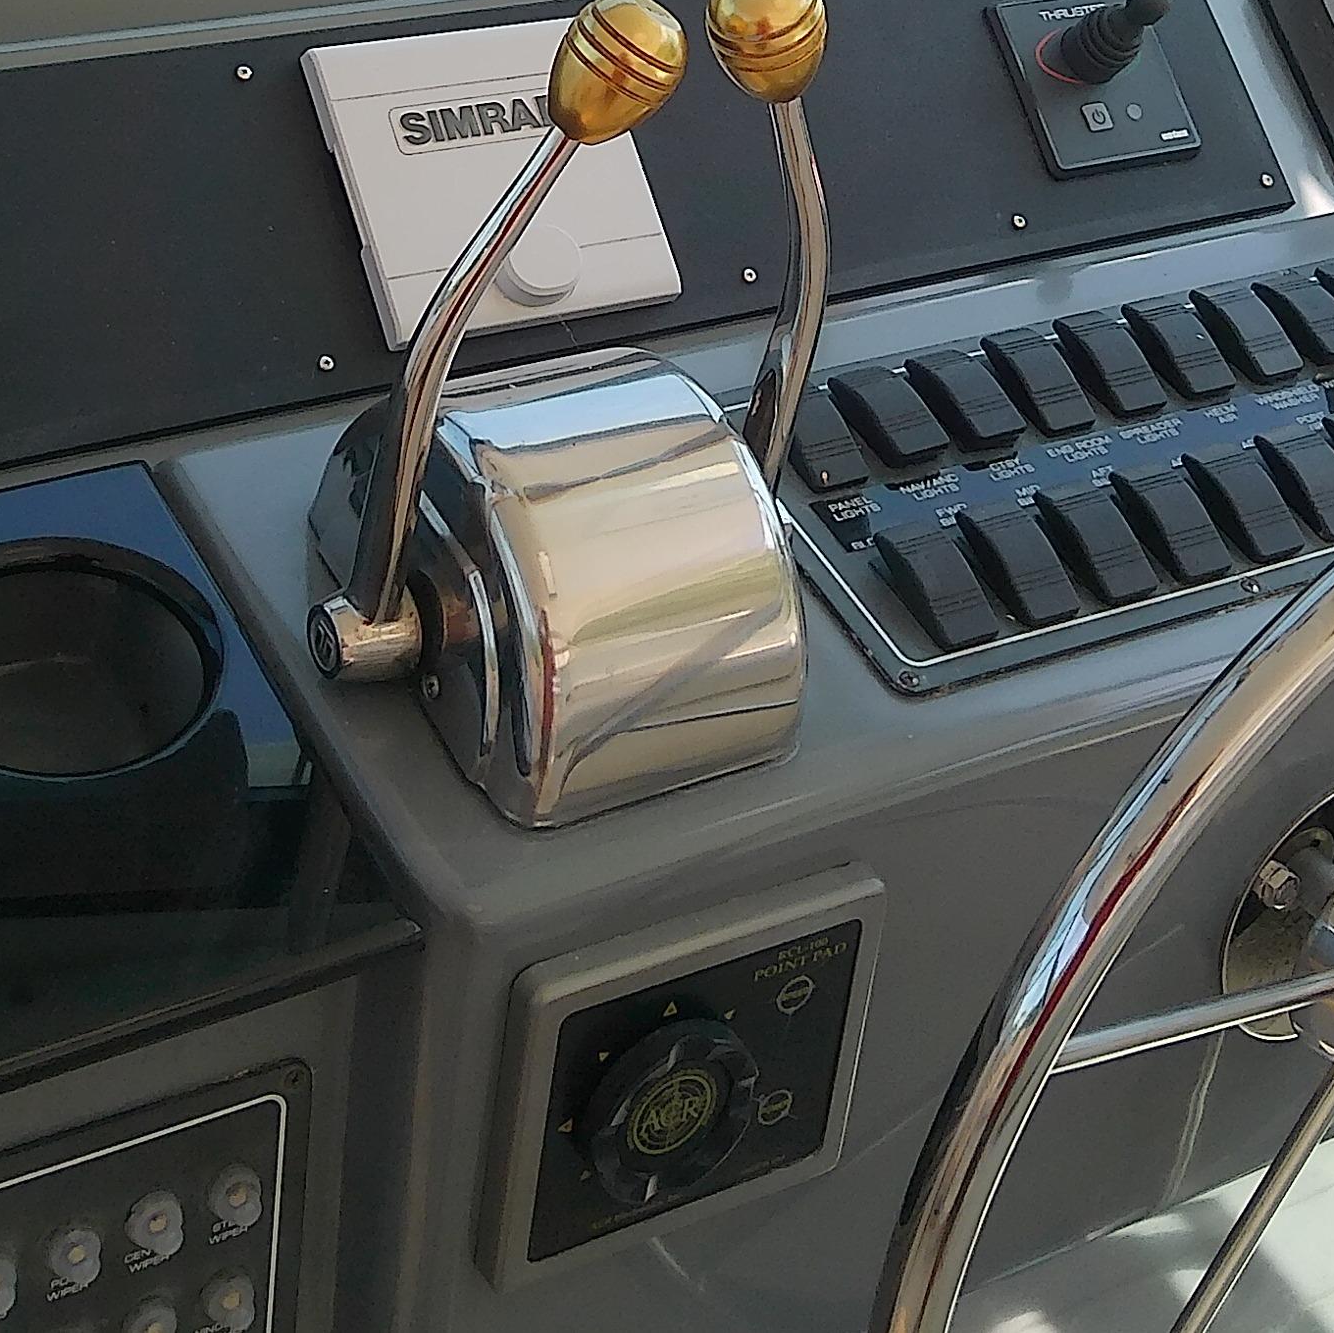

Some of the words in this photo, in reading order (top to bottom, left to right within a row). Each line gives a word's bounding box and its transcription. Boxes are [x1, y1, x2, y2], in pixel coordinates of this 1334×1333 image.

[399, 94, 551, 145] SIMRA
[1136, 427, 1181, 446] LIGHTS
[1063, 444, 1110, 464] LIGHTS
[989, 463, 1037, 482] LIGHTS
[912, 482, 961, 502] LIGHTS
[827, 495, 875, 514] PANEL
[832, 502, 883, 523] LIGHTS
[753, 955, 806, 983] POINT
[811, 941, 848, 963] PAD
[208, 1224, 250, 1246] WIPER
[127, 1253, 172, 1275] WIPER
[46, 1281, 91, 1303] WIPER
